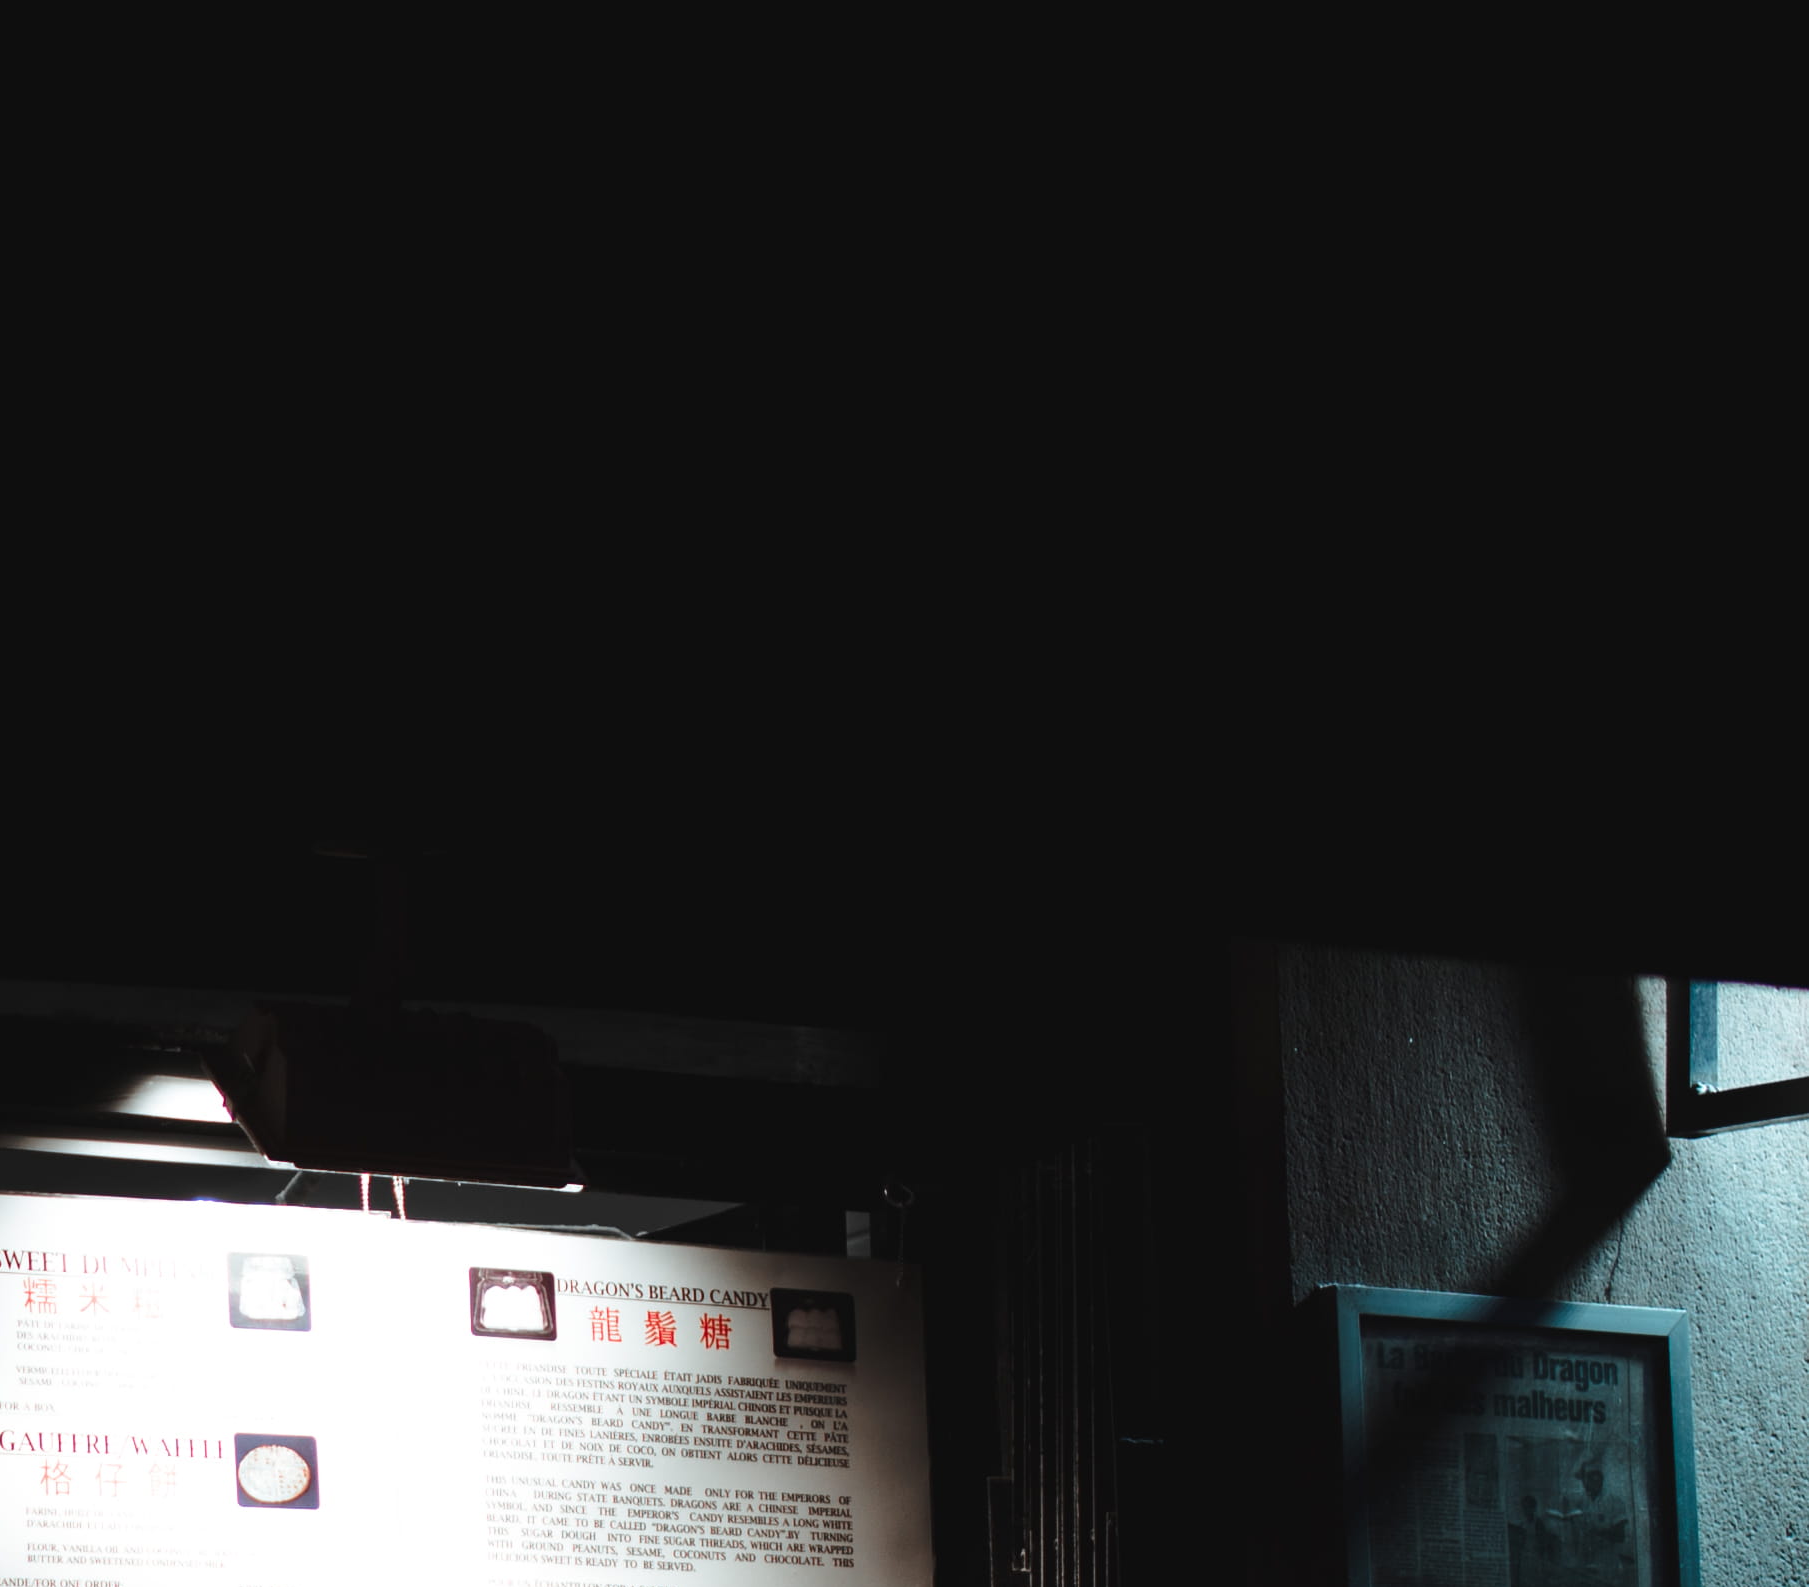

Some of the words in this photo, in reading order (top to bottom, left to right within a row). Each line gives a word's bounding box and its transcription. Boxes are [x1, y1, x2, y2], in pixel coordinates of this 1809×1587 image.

[557, 1278, 645, 1300] DRAGON'S
[648, 1284, 705, 1303] BEARD
[709, 1288, 769, 1308] CANDY
[589, 1305, 733, 1350] 龍鬚糖
[1533, 1350, 1619, 1391] Dragon
[1493, 1390, 1608, 1425] malheurs
[702, 1424, 779, 1440] TRANSFORMANT
[744, 1414, 789, 1428] BLANCHE
[758, 1503, 799, 1515] CHINESE
[672, 1549, 727, 1562] COCONUTS
[734, 1552, 757, 1563] AND
